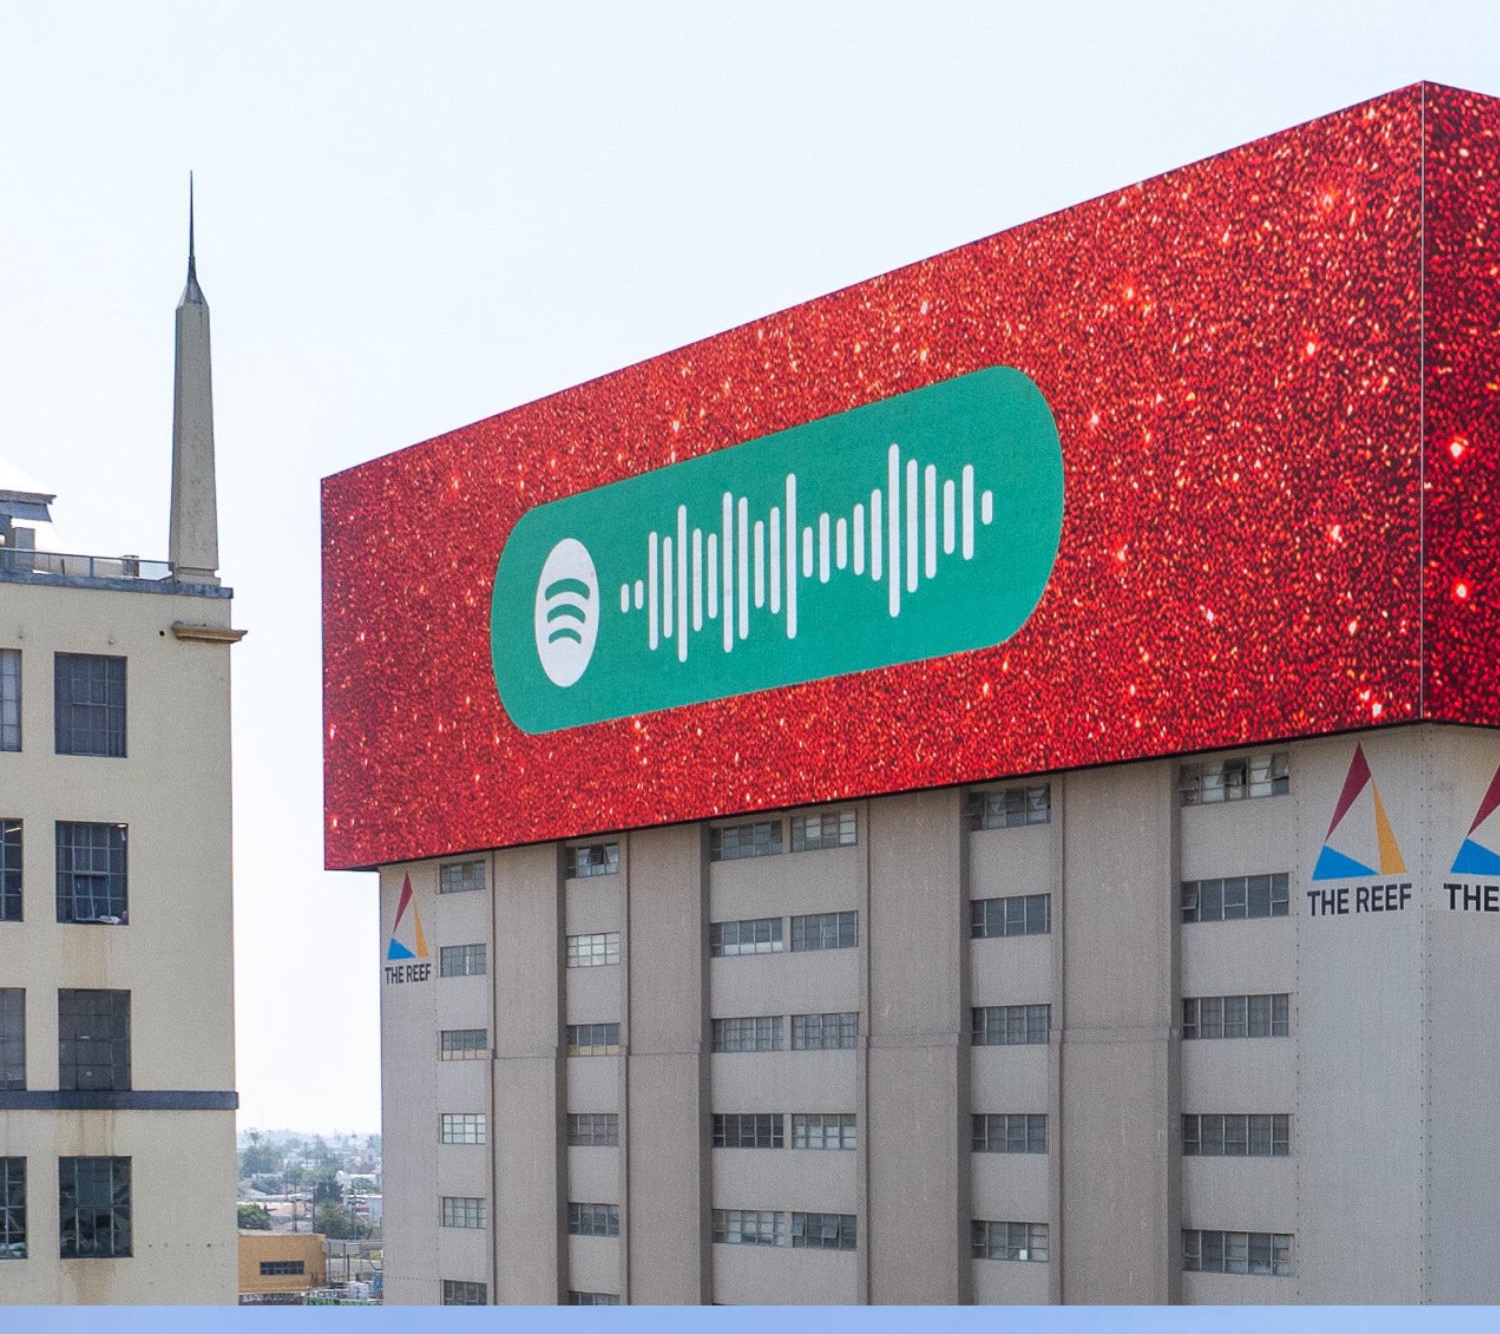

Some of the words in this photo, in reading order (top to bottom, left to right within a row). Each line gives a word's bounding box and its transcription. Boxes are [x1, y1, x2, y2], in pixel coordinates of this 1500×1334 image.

[1306, 888, 1350, 917] THE
[1355, 882, 1413, 913] REEF
[1443, 883, 1500, 913] THE
[385, 966, 405, 985] THE
[406, 963, 432, 983] REEF
